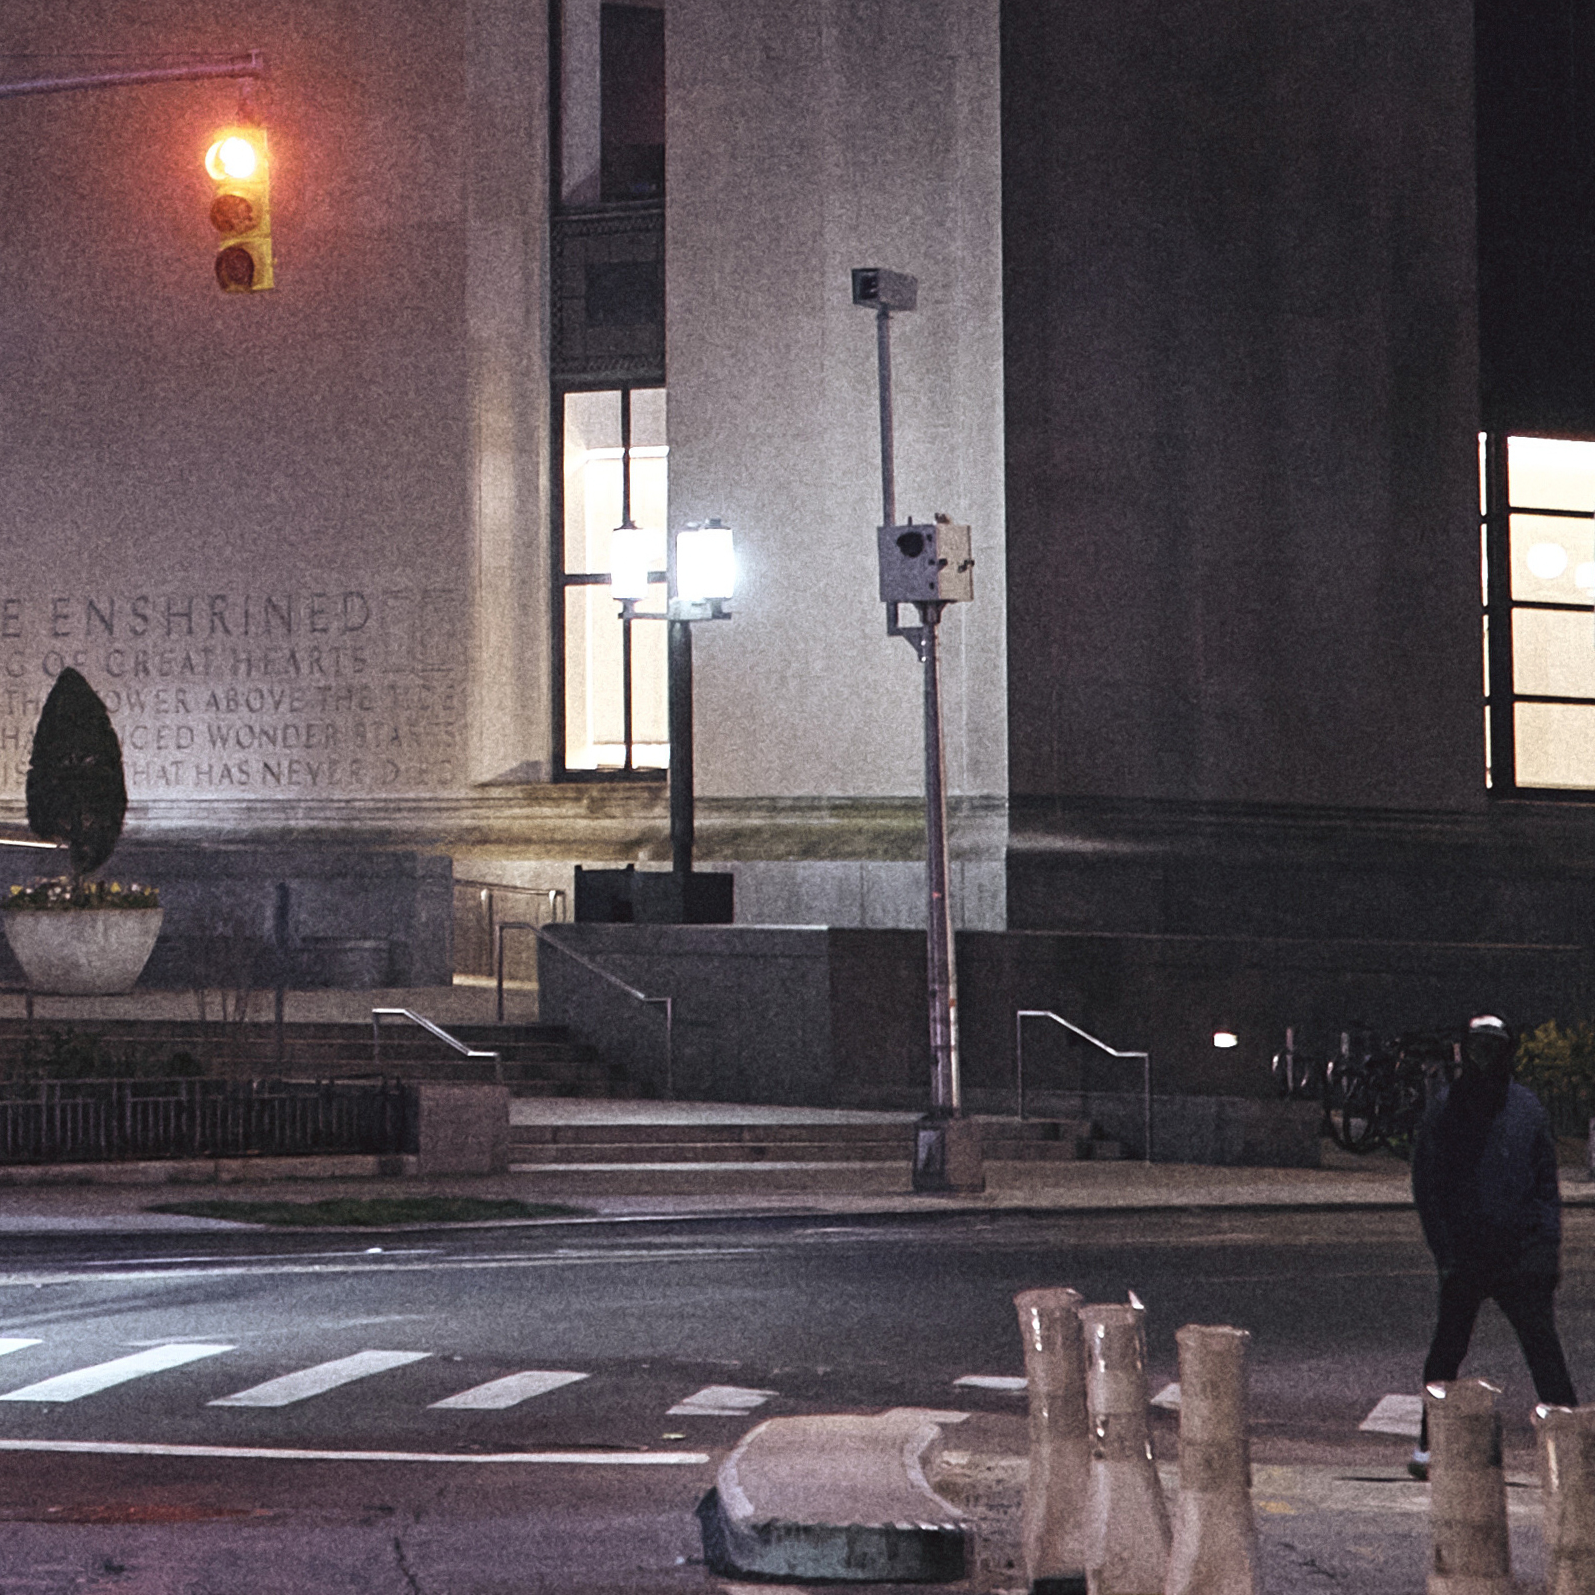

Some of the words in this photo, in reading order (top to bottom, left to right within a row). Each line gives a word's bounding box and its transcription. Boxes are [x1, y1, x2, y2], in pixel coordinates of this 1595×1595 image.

[50, 591, 372, 639] ENSHRINED
[41, 649, 88, 679] OF
[104, 646, 214, 679] GREAT
[229, 644, 369, 677] HEARTS
[205, 685, 305, 714] ABOVE
[315, 684, 374, 713] THE
[206, 722, 339, 751] WONDER
[194, 759, 251, 787] HAS
[260, 758, 362, 787] NEVER
